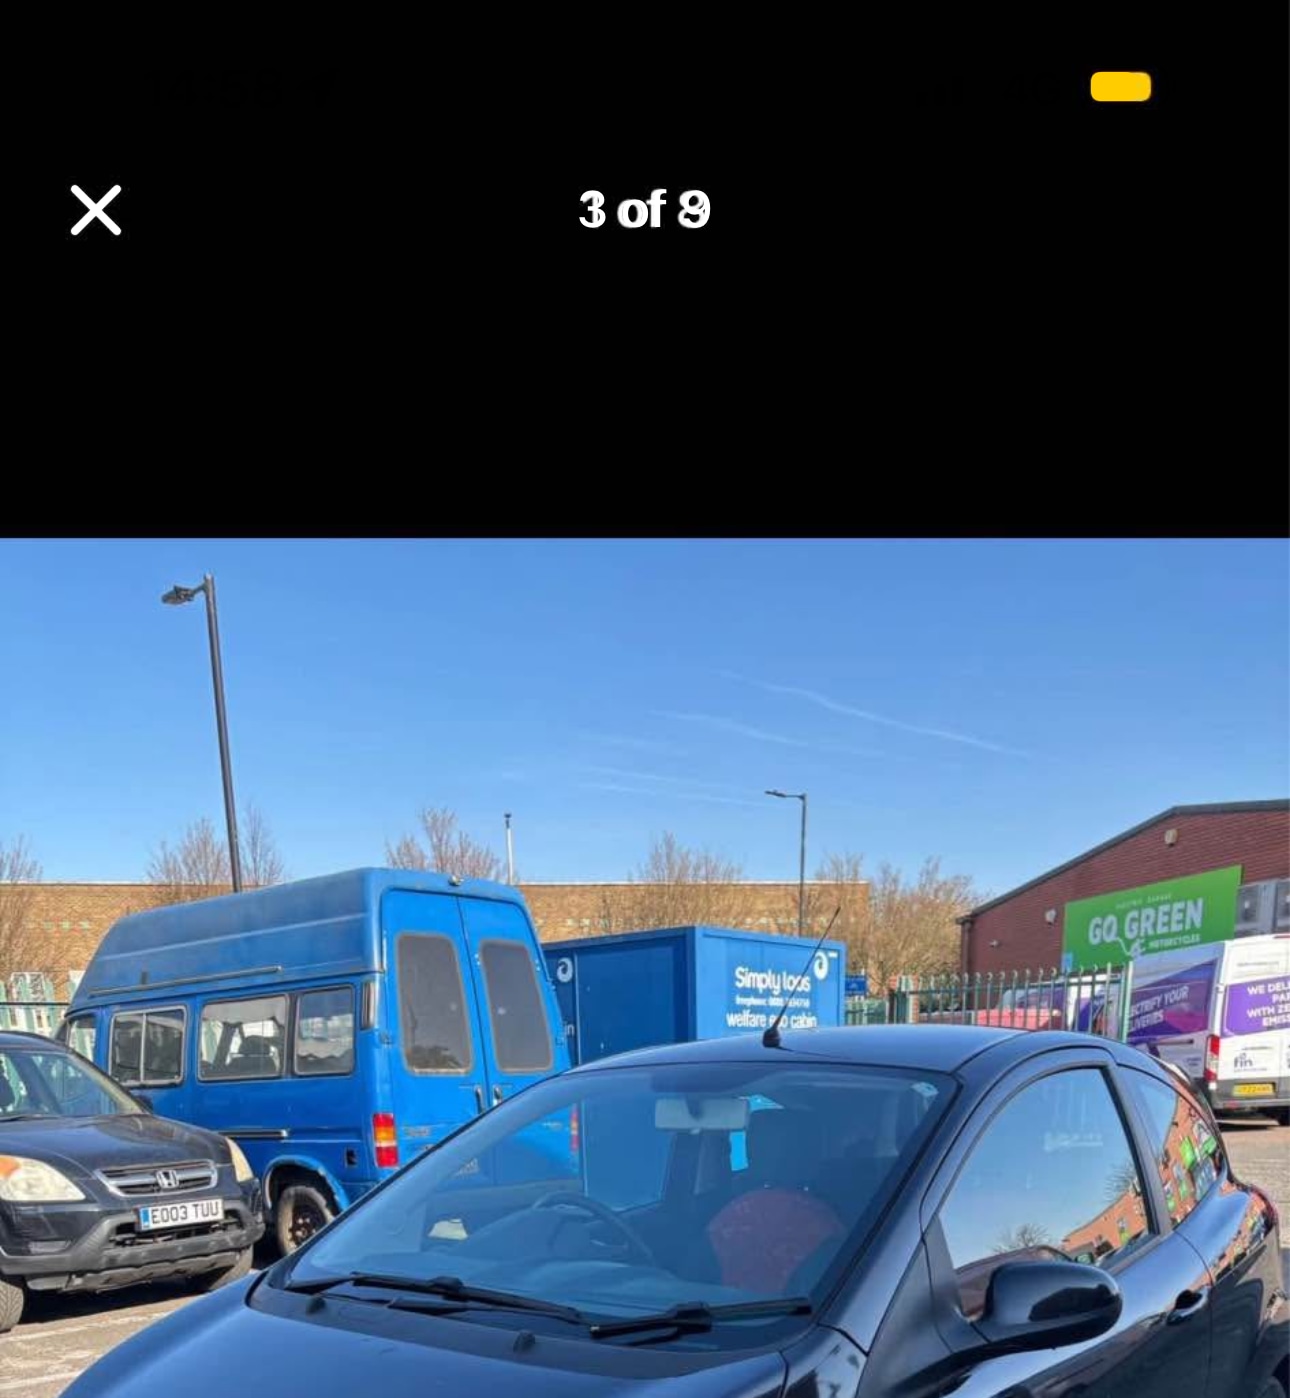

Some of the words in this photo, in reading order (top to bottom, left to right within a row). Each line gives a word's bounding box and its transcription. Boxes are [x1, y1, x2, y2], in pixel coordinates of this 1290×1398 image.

[1088, 914, 1118, 945] GO
[1124, 898, 1204, 940] GREEN
[735, 966, 781, 995] Simply
[1247, 984, 1266, 995] WE
[726, 1008, 767, 1027] welfare
[790, 1012, 817, 1029] cabin
[1246, 1005, 1276, 1018] WITH
[192, 1201, 219, 1219] TUU
